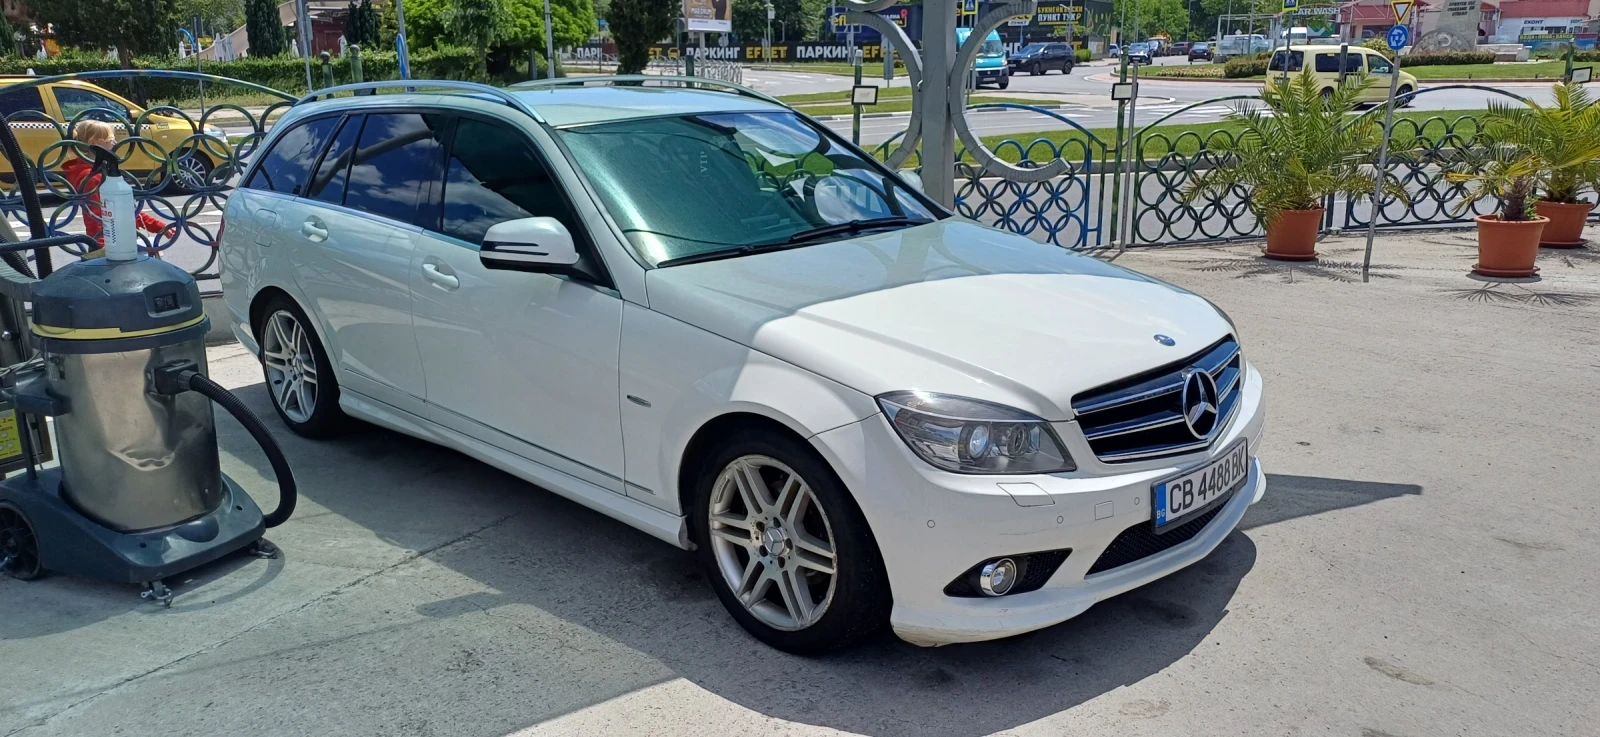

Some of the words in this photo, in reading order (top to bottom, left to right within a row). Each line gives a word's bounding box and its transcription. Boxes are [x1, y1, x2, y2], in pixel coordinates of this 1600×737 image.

[1314, 7, 1340, 15] WASH
[686, 47, 740, 59] ПАРКИНГ
[1170, 479, 1194, 514] CB
[1198, 459, 1230, 501] 4488
[1232, 445, 1245, 482] BK
[1157, 509, 1165, 519] BG
